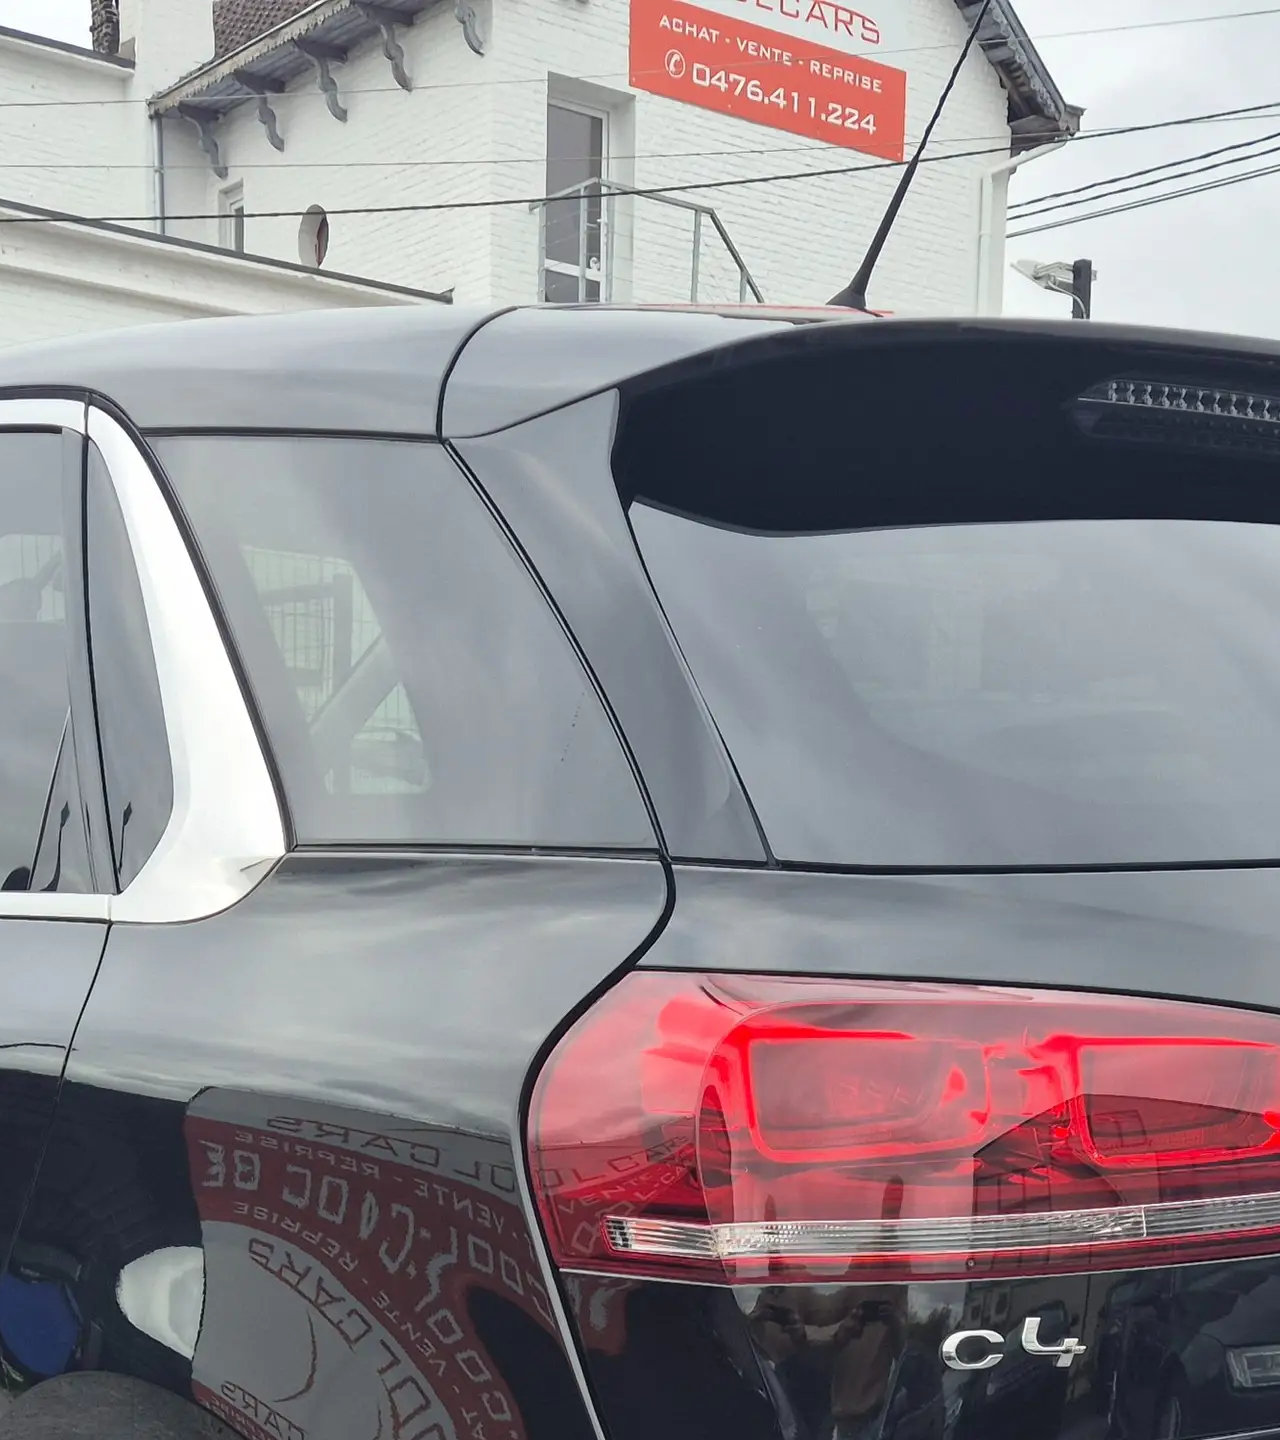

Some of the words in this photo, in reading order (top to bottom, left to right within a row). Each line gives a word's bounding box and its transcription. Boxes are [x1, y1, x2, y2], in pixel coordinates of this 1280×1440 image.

[659, 15, 720, 44] ACHAT
[736, 37, 792, 65] VENTE
[810, 59, 883, 93] REPRISE
[692, 63, 877, 135] 0476.411.224
